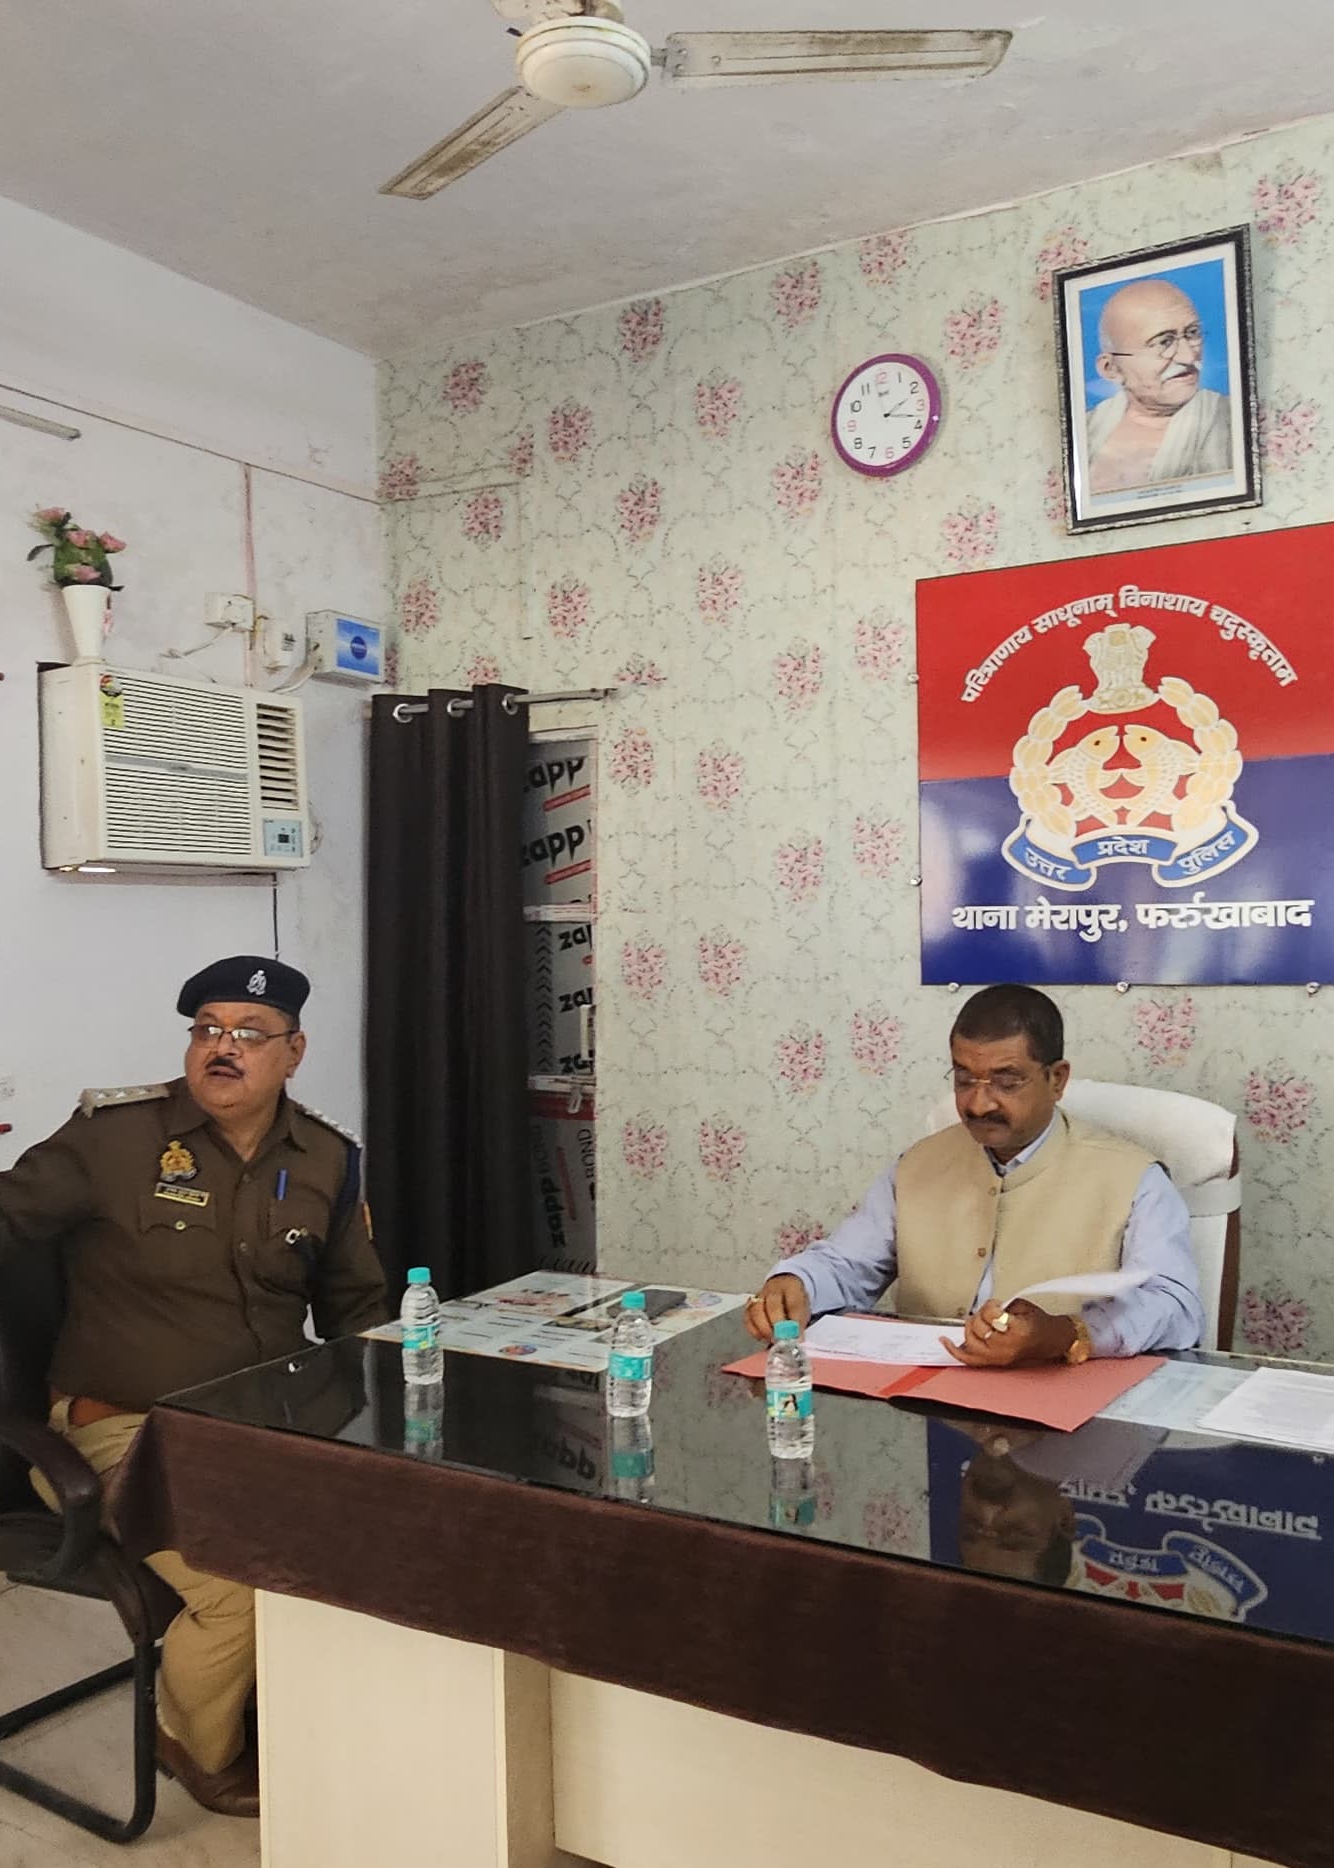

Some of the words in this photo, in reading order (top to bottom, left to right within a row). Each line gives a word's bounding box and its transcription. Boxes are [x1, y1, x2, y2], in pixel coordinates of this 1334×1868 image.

[861, 383, 870, 396] 11
[910, 381, 919, 395] 2
[850, 400, 862, 413] 10
[916, 399, 924, 411] 3
[914, 419, 923, 430] 4
[853, 437, 862, 449] 8
[902, 436, 911, 449] 5
[868, 446, 876, 459] 7
[1119, 584, 1209, 617] विनाशाय
[1023, 848, 1072, 881] उत्तर
[1097, 836, 1150, 856] प्रदेश
[1177, 831, 1236, 876] पुलिस
[952, 905, 1018, 930] थाना
[1025, 896, 1128, 942] मेरापुर,
[1136, 892, 1315, 930] फर्रुखाबाद
